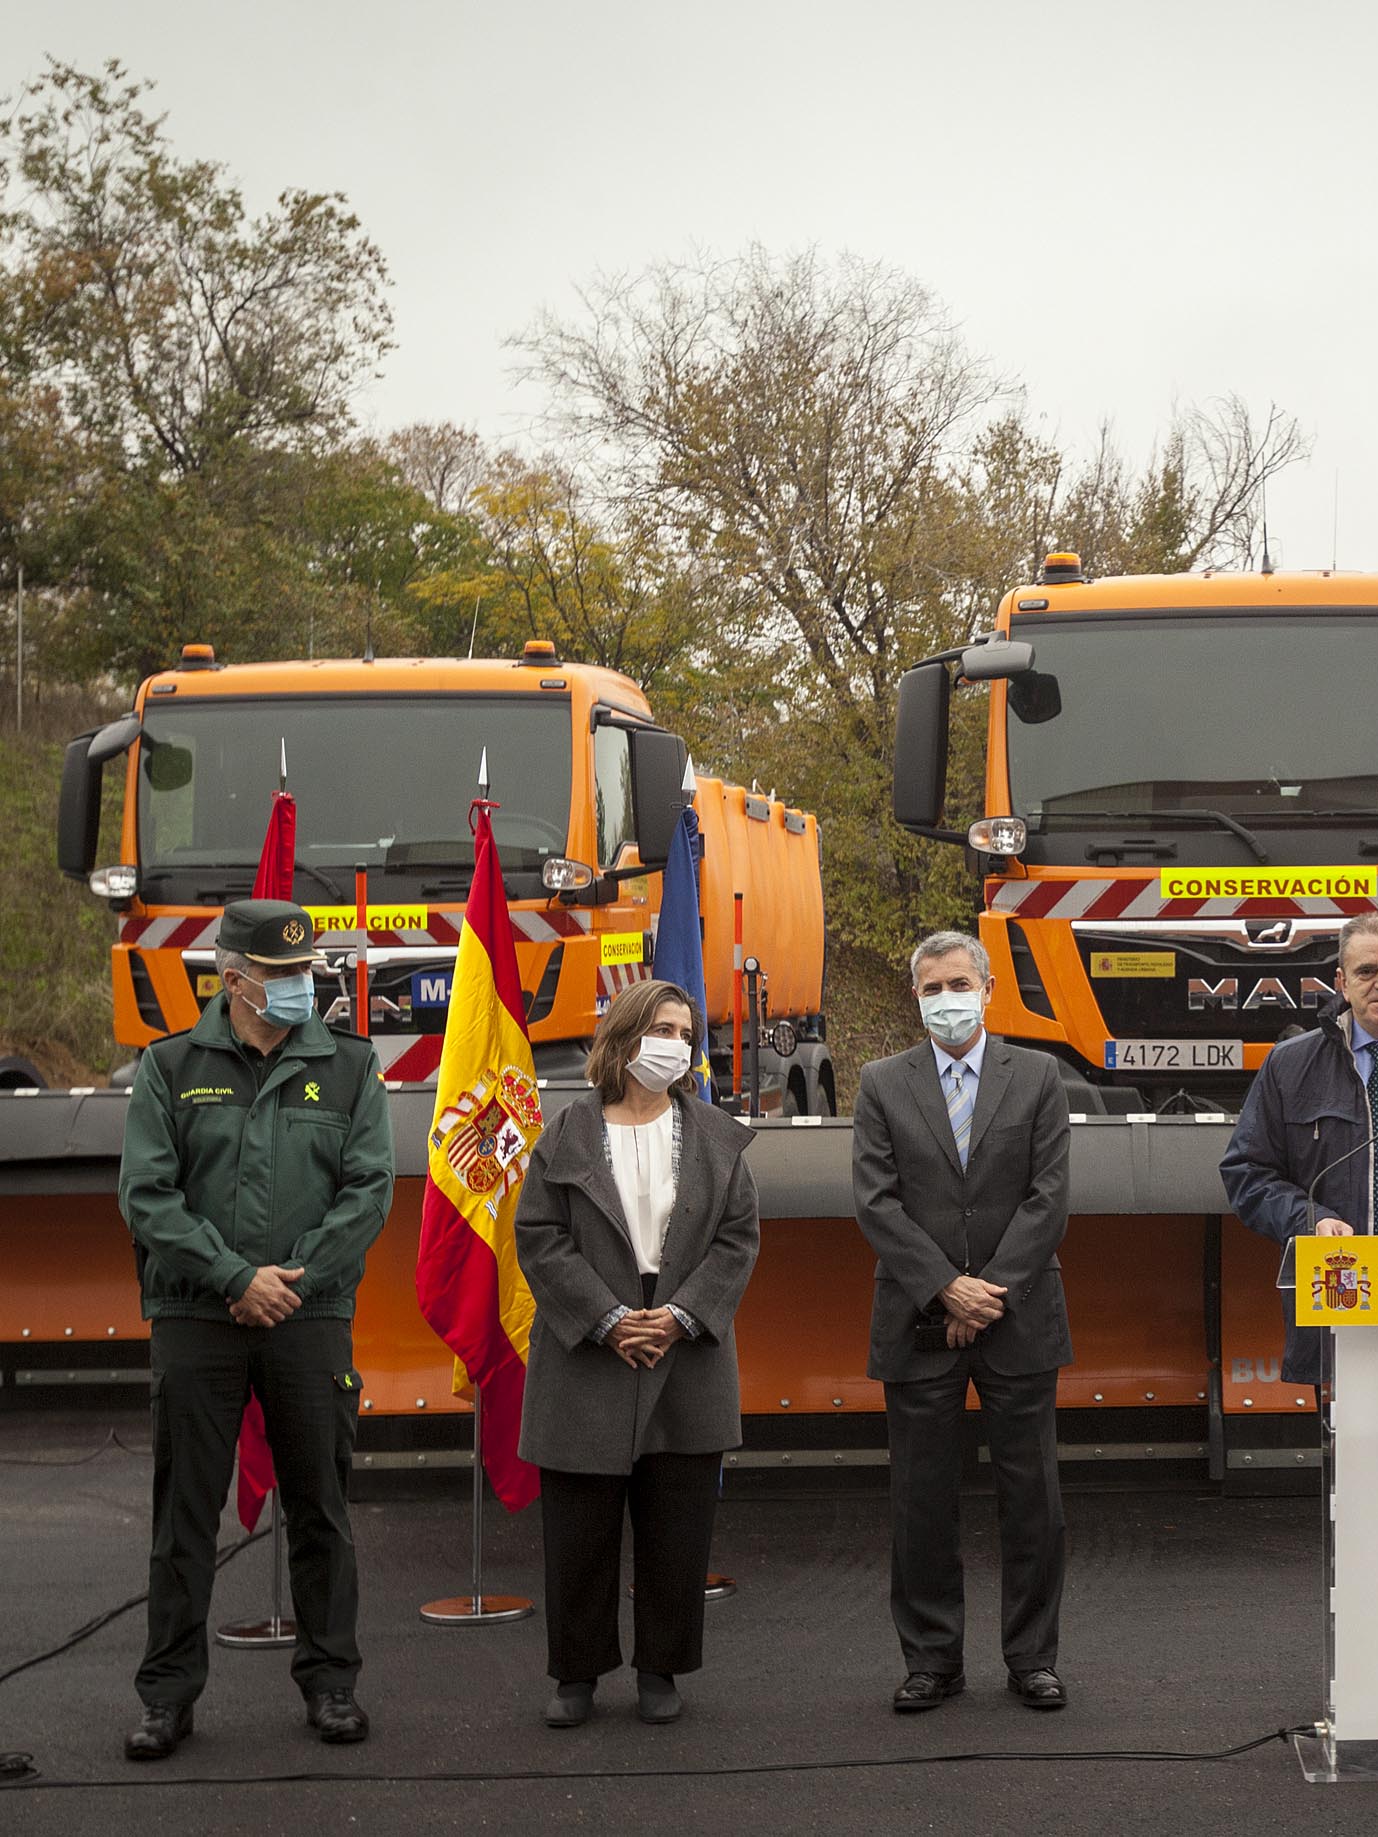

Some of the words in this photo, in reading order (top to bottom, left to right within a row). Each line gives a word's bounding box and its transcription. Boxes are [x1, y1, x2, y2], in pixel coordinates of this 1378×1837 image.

[1169, 875, 1370, 896] CONSERVACIÓN
[314, 912, 422, 930] ERVCIÓN
[1123, 1044, 1180, 1066] 4172
[1193, 1044, 1234, 1066] LDK
[180, 1087, 214, 1099] GUARDIA
[214, 1087, 235, 1095] CIVIL
[1231, 1357, 1279, 1384] BU
